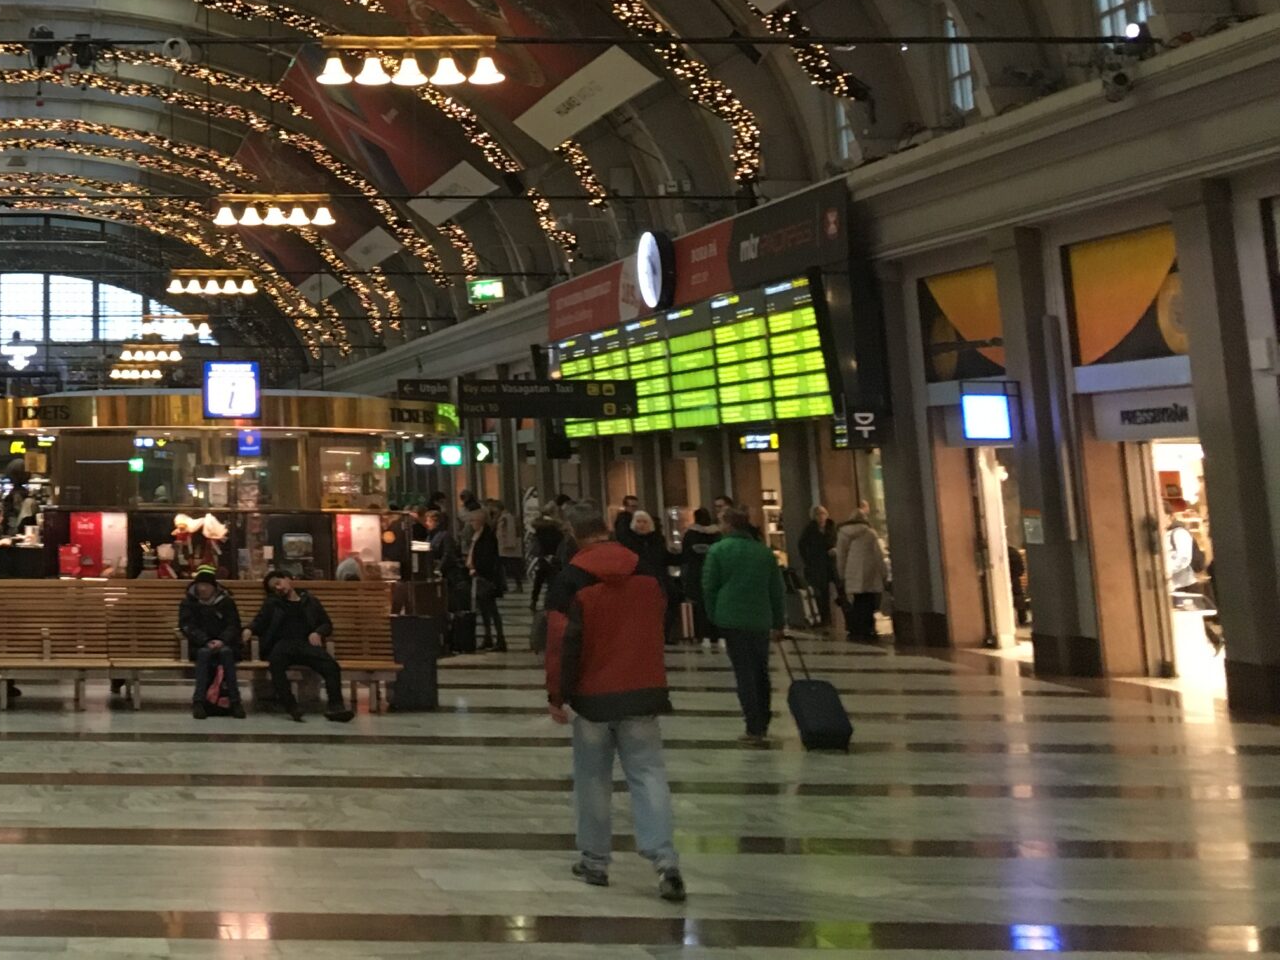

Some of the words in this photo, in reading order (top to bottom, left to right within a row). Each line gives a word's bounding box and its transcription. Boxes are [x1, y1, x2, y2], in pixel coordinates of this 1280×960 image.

[419, 382, 449, 395] Utgån
[501, 383, 550, 395] Vasagatan
[555, 383, 574, 393] Taxi
[17, 405, 70, 420] TICKETS
